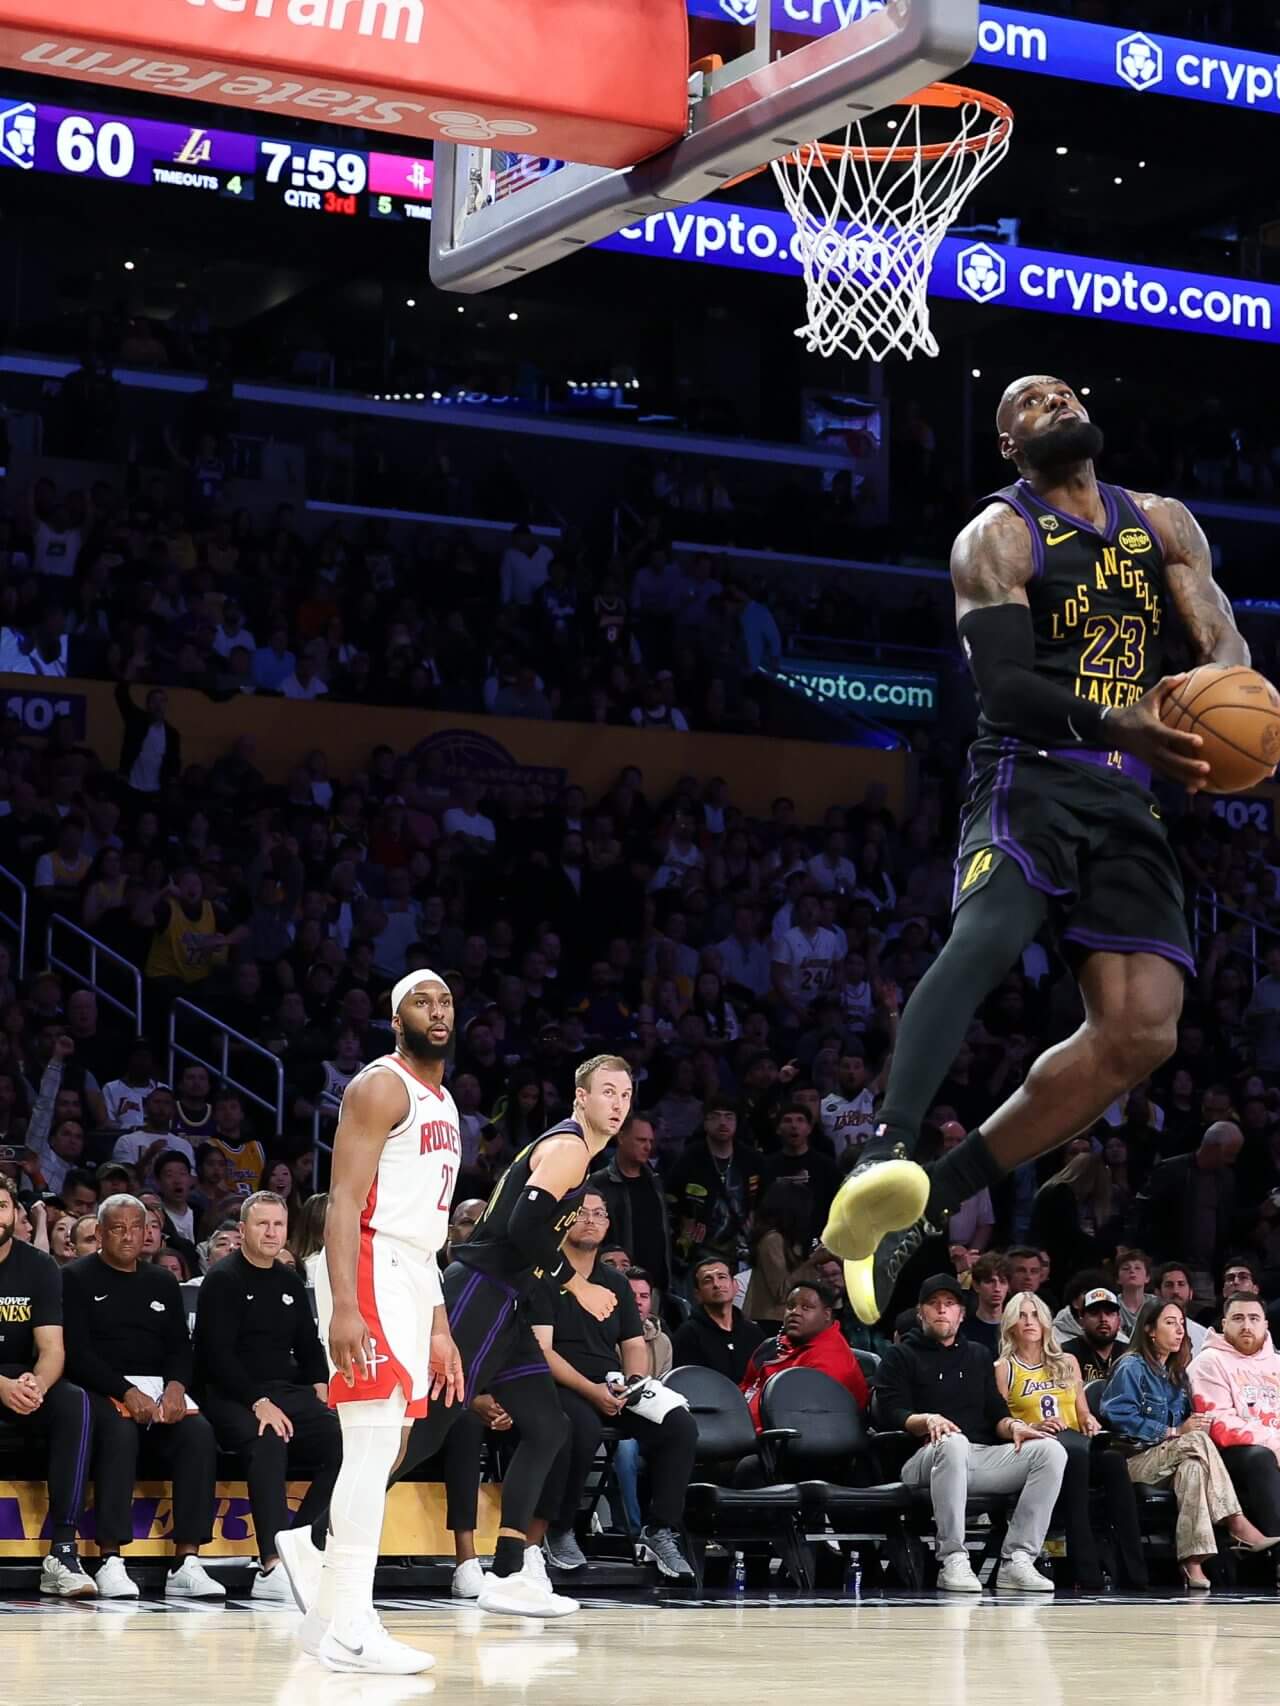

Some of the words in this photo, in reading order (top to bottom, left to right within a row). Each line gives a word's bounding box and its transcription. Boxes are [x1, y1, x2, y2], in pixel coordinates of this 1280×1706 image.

[56, 116, 135, 177] 60
[261, 142, 366, 194] 7:59
[153, 169, 218, 190] TIMEOUTS
[227, 176, 242, 194] 4
[284, 190, 320, 210] QTR
[324, 195, 355, 214] 3rd
[378, 196, 391, 213] 5
[1020, 261, 1271, 329] crypto.com
[1052, 584, 1089, 638] LOS
[1080, 615, 1146, 680] 23
[1107, 750, 1123, 769] LAL
[437, 1164, 454, 1211] 21
[1040, 1395, 1056, 1419] 8
